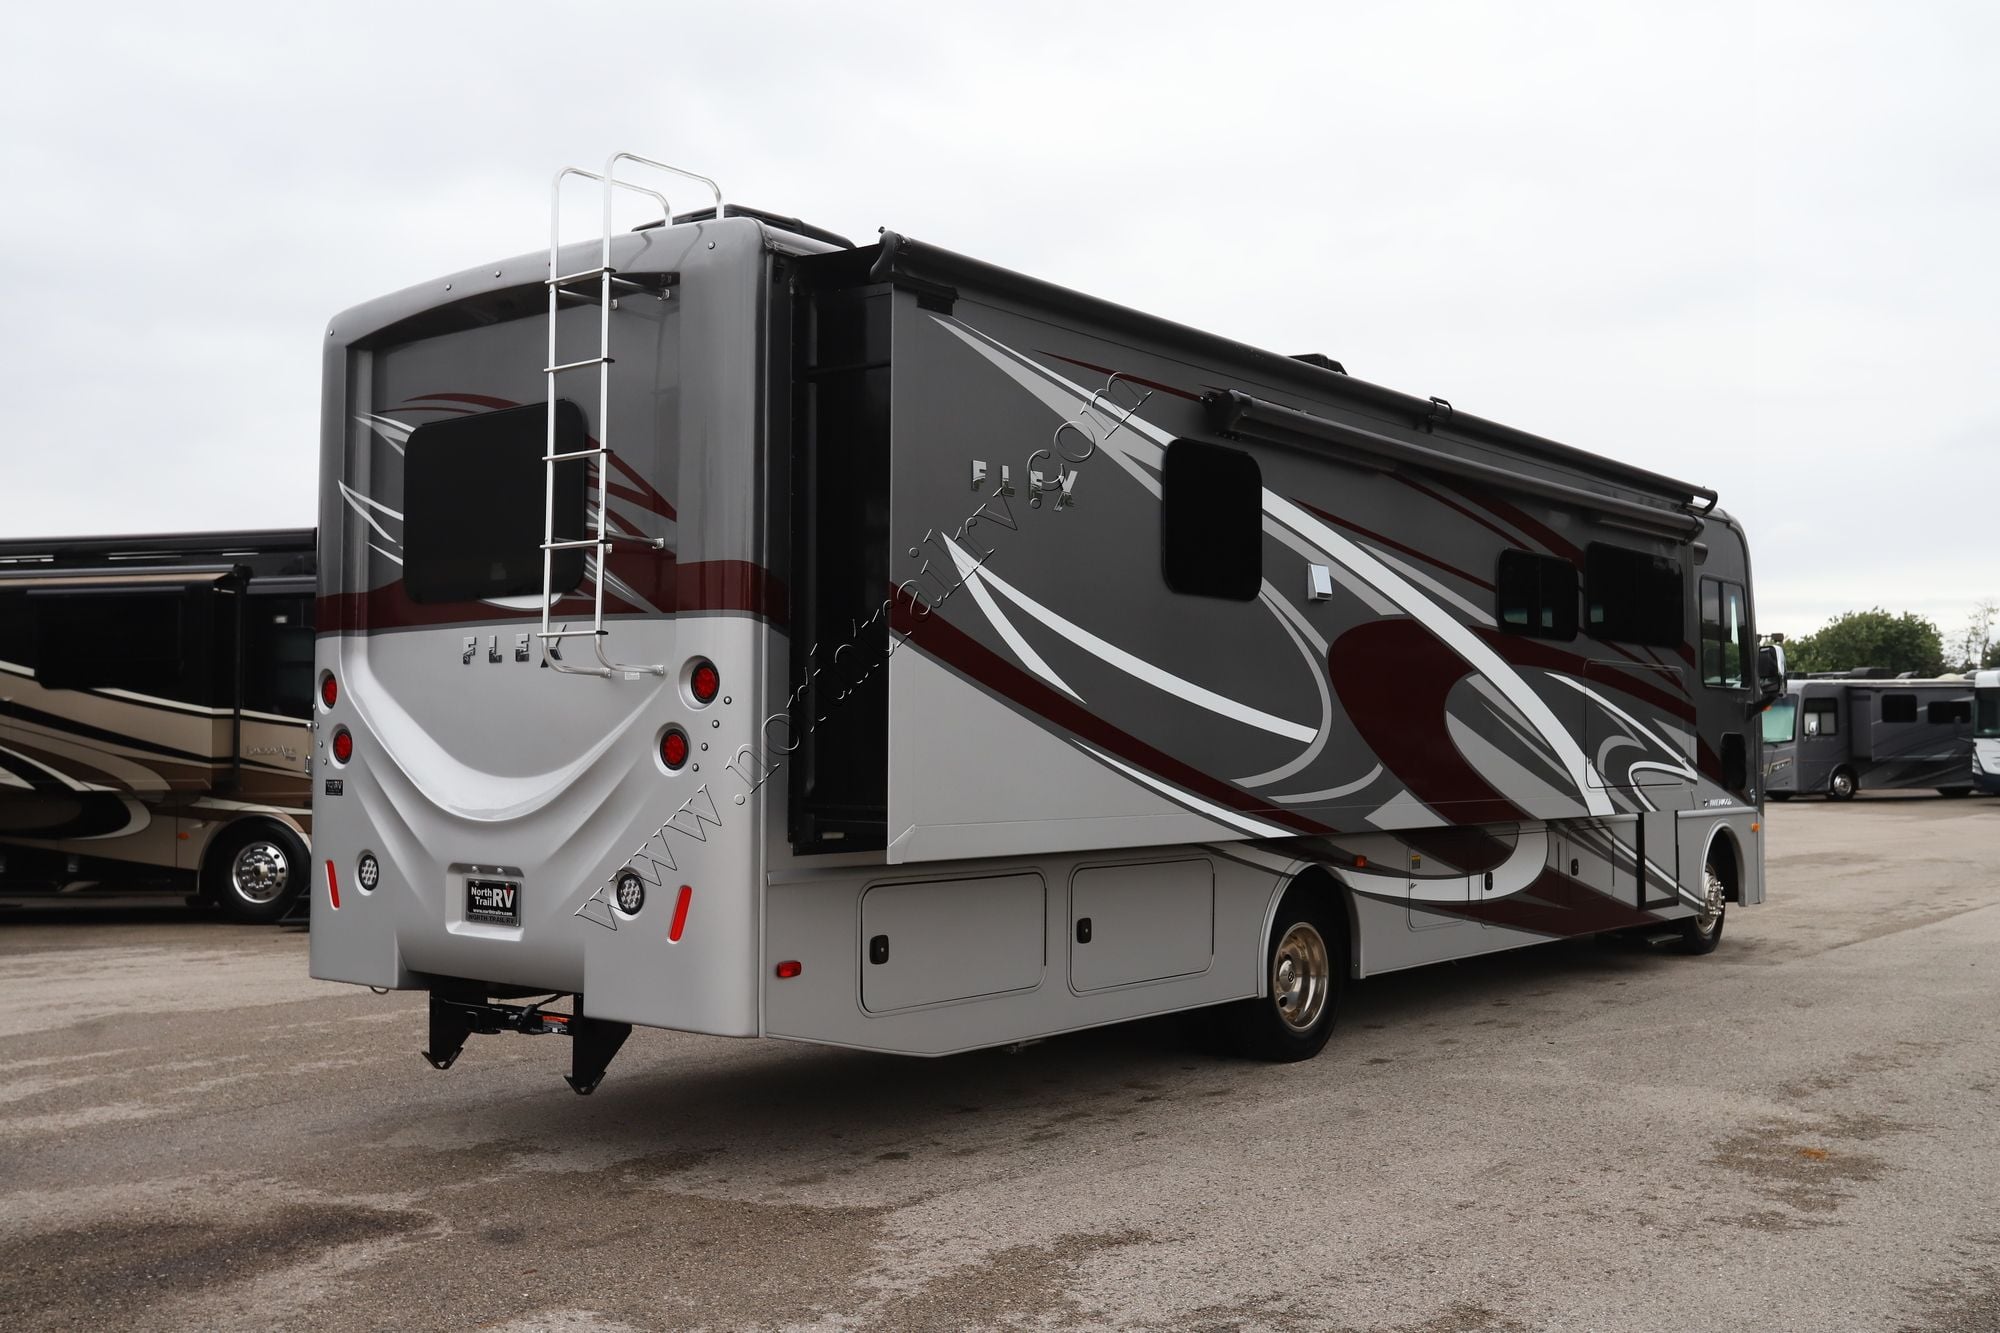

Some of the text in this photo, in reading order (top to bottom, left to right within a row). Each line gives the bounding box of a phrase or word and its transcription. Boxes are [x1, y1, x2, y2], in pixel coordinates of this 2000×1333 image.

[971, 459, 1078, 511] FLEX
[471, 887, 492, 897] North
[492, 888, 514, 908] RV
[475, 897, 492, 906] Trail
